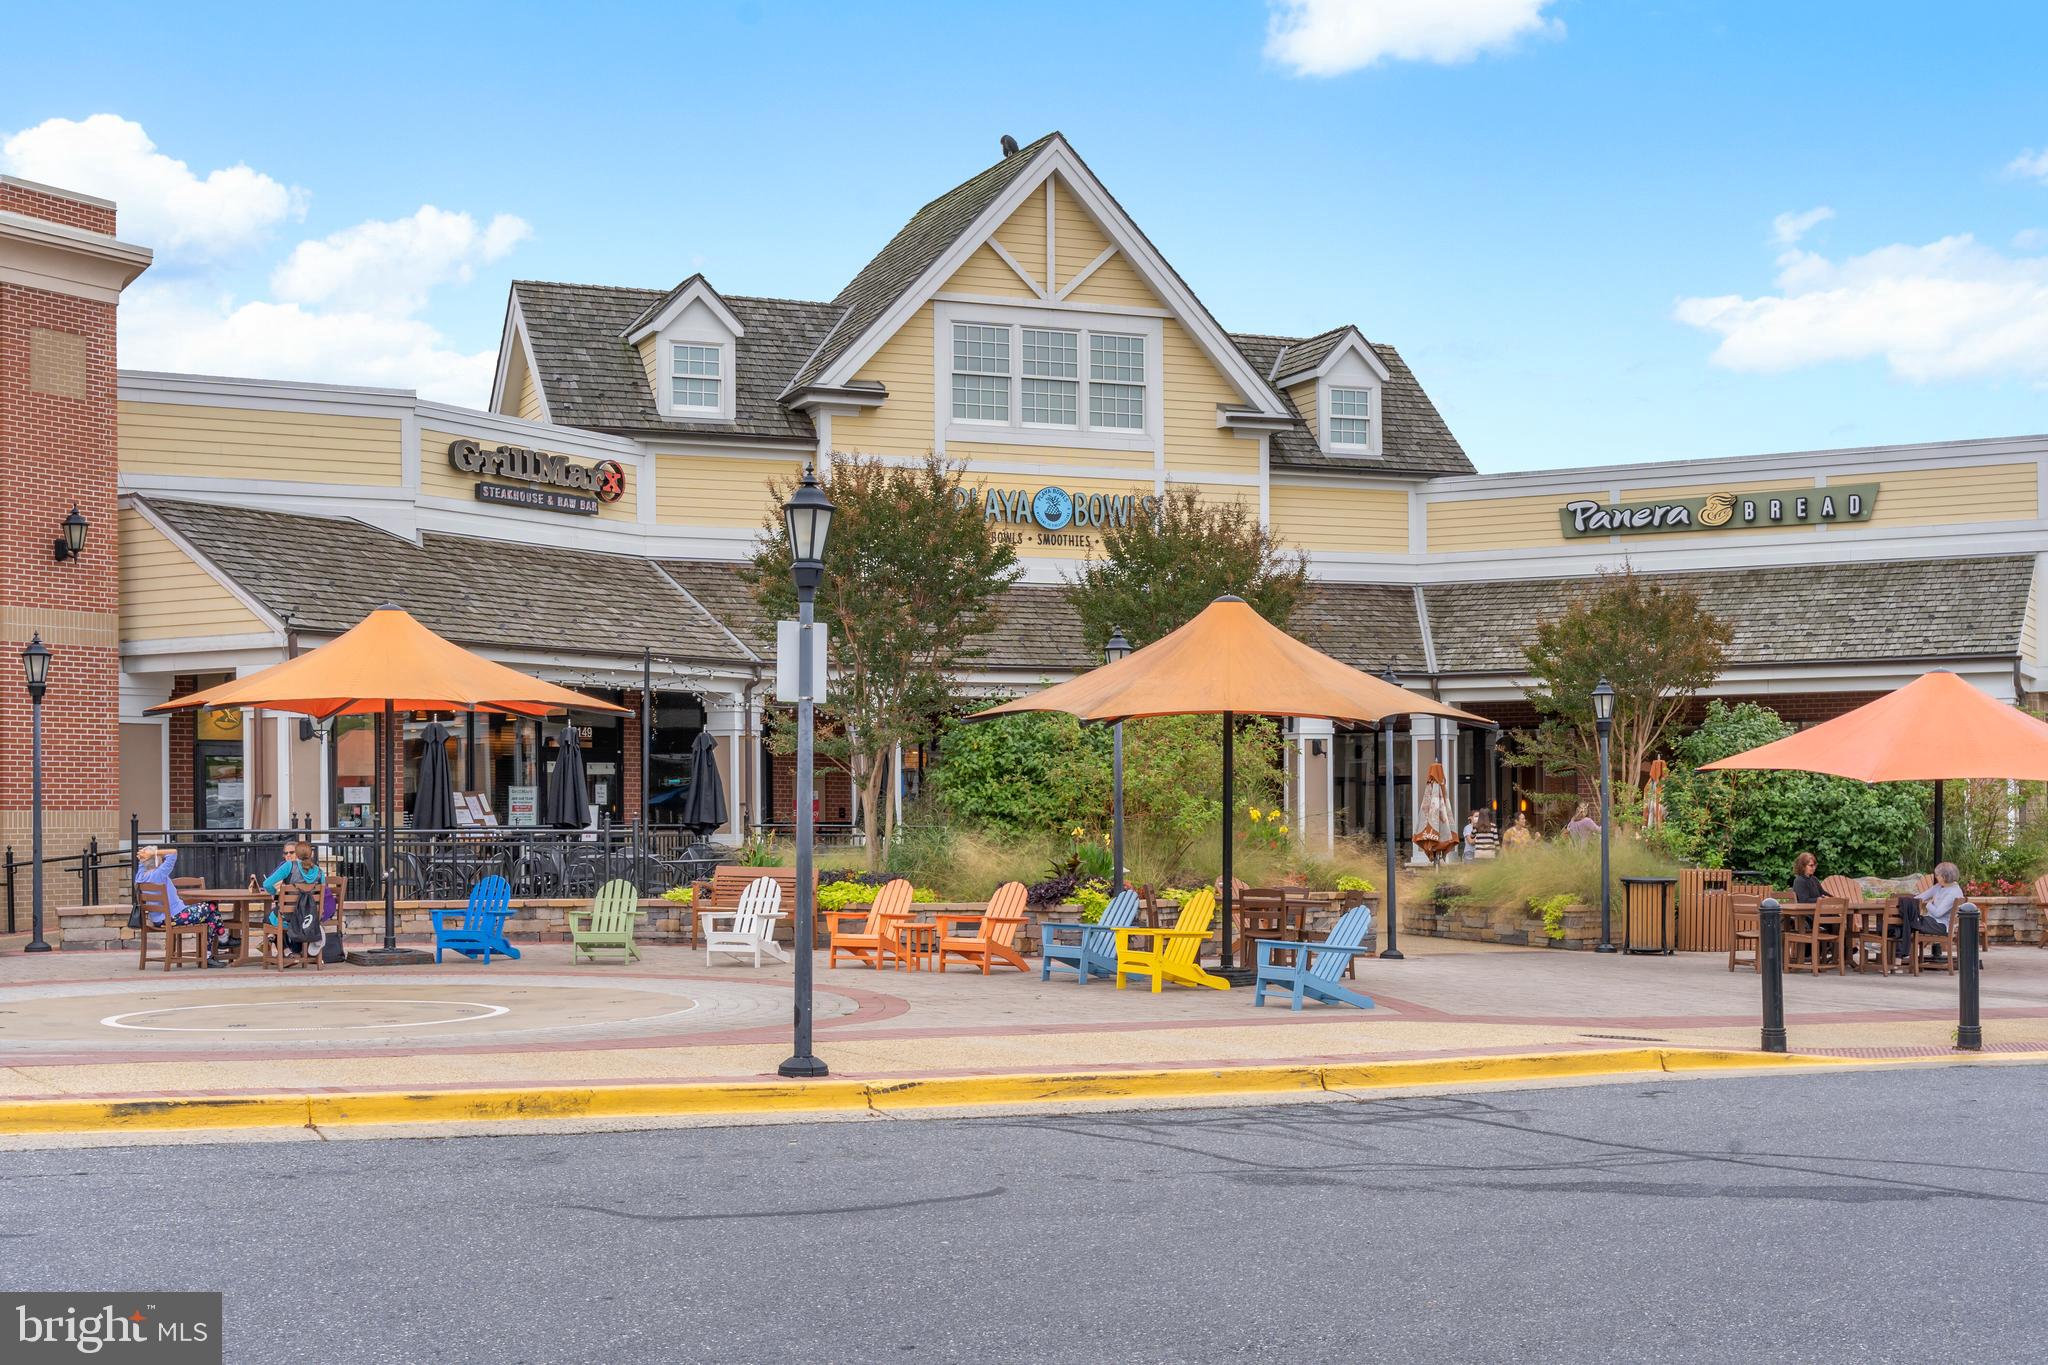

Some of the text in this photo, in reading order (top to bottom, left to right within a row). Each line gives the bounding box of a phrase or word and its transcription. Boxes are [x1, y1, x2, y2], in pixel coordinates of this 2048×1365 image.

[448, 439, 622, 495] GrillMarx
[482, 486, 598, 511] STEAKHOUSE & RAW BAR
[1567, 494, 1861, 532] Panera BREAD
[1036, 533, 1091, 547] SMOOTHIES
